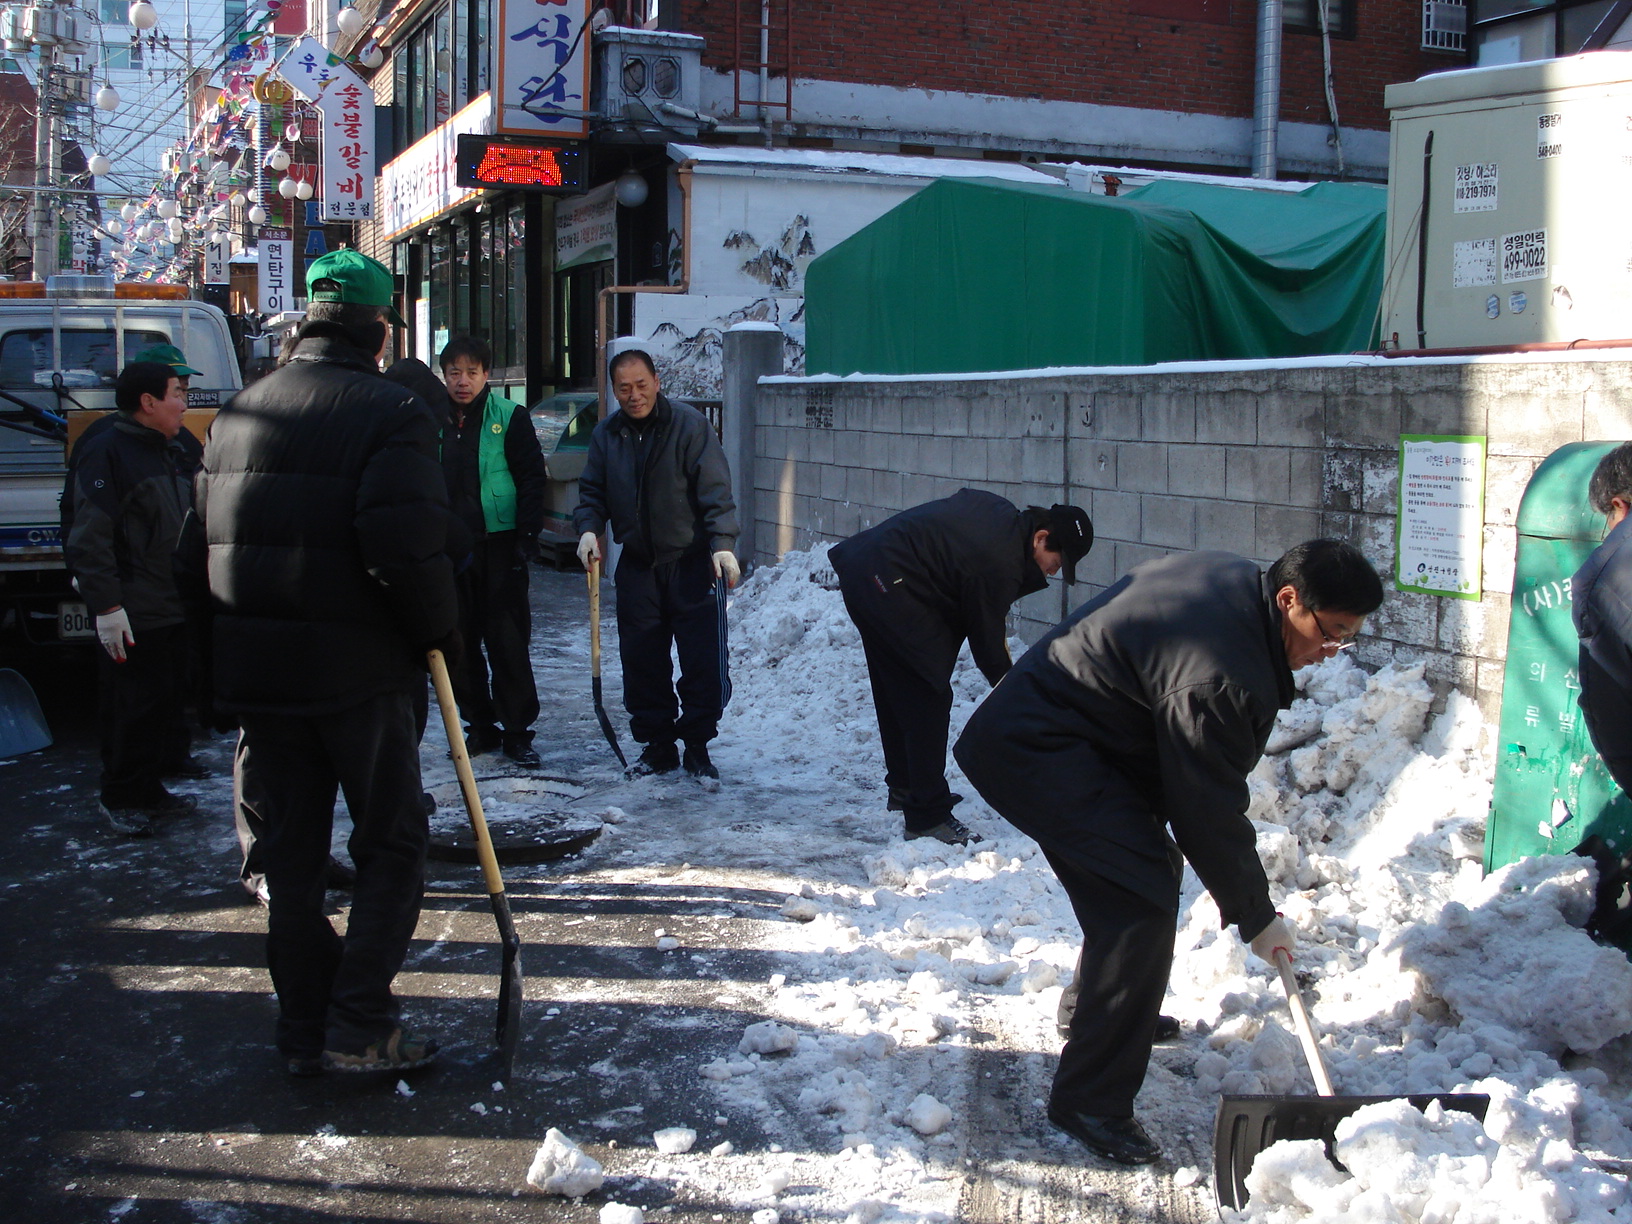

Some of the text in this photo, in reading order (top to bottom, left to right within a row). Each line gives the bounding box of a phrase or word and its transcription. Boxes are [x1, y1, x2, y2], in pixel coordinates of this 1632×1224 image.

[510, 13, 582, 124] 식당
[334, 84, 369, 200] 숯불갈비
[264, 230, 288, 239] 서소문
[330, 201, 370, 217] 전문점
[1503, 230, 1546, 252] 성일인력
[267, 243, 285, 312] 연탄구이
[1503, 246, 1546, 272] 499-0022
[1524, 662, 1546, 728] 의류
[1558, 666, 1580, 734] 신발
